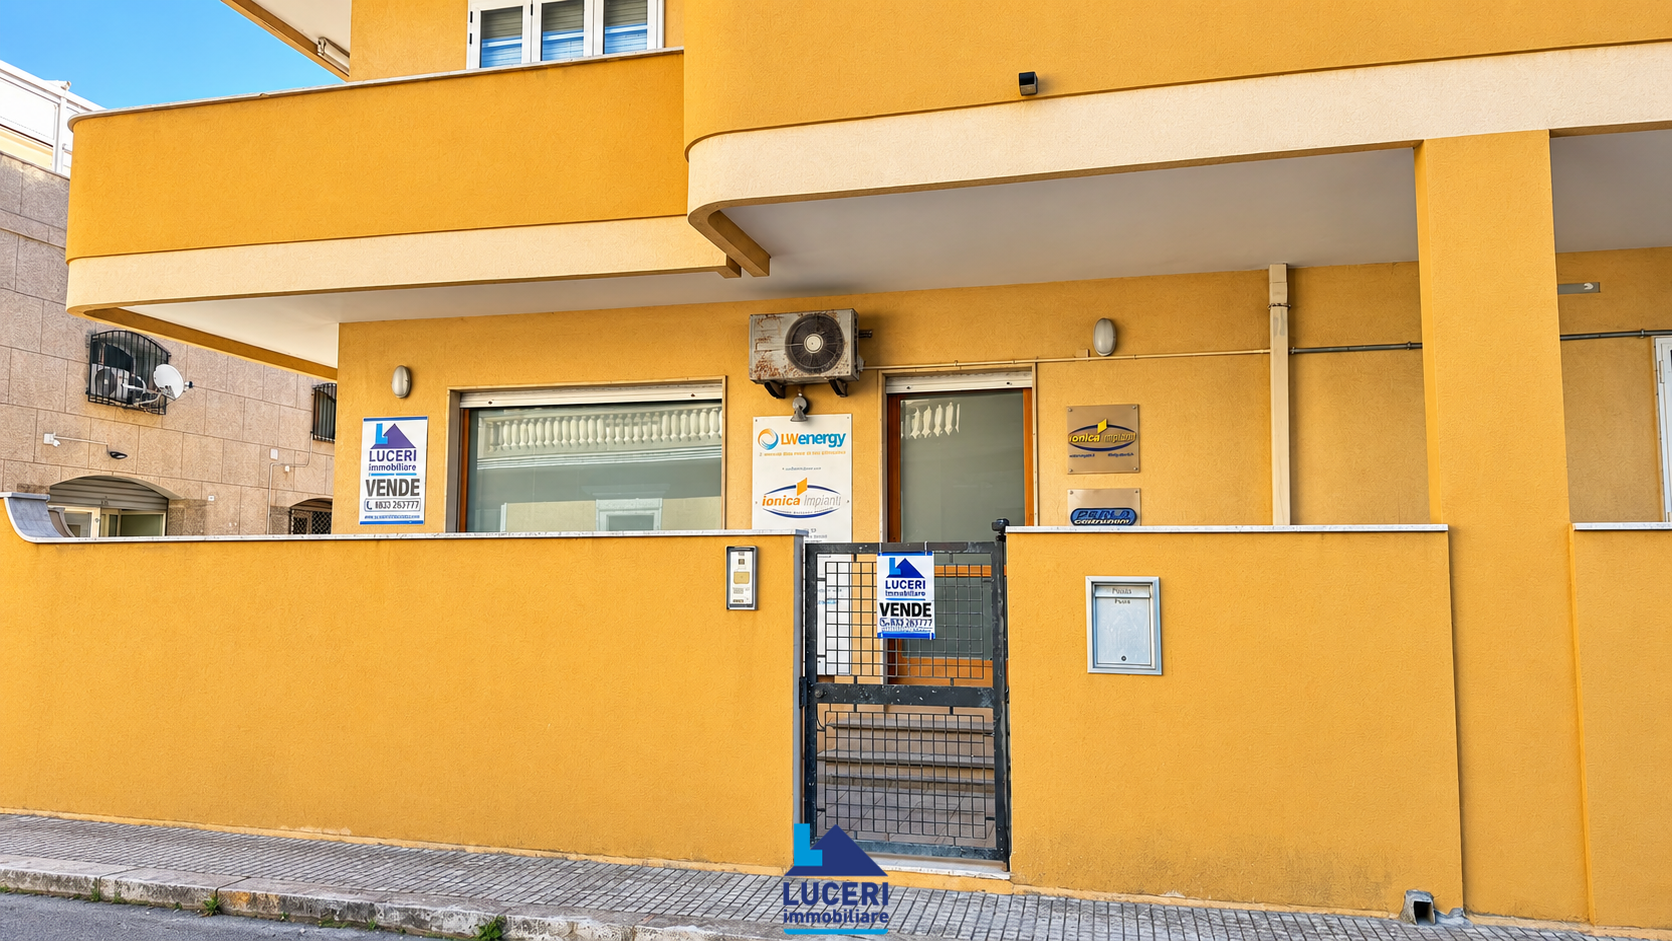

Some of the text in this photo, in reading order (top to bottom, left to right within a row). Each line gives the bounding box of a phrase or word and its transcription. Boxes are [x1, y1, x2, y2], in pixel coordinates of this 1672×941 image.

[781, 433, 846, 448] LWenergy
[369, 450, 417, 462] LUCERI
[368, 463, 417, 471] immobiliare
[365, 478, 420, 497] VENDE
[762, 495, 801, 506] ionica
[885, 580, 926, 590] LUCERI
[879, 602, 932, 618] VENDE
